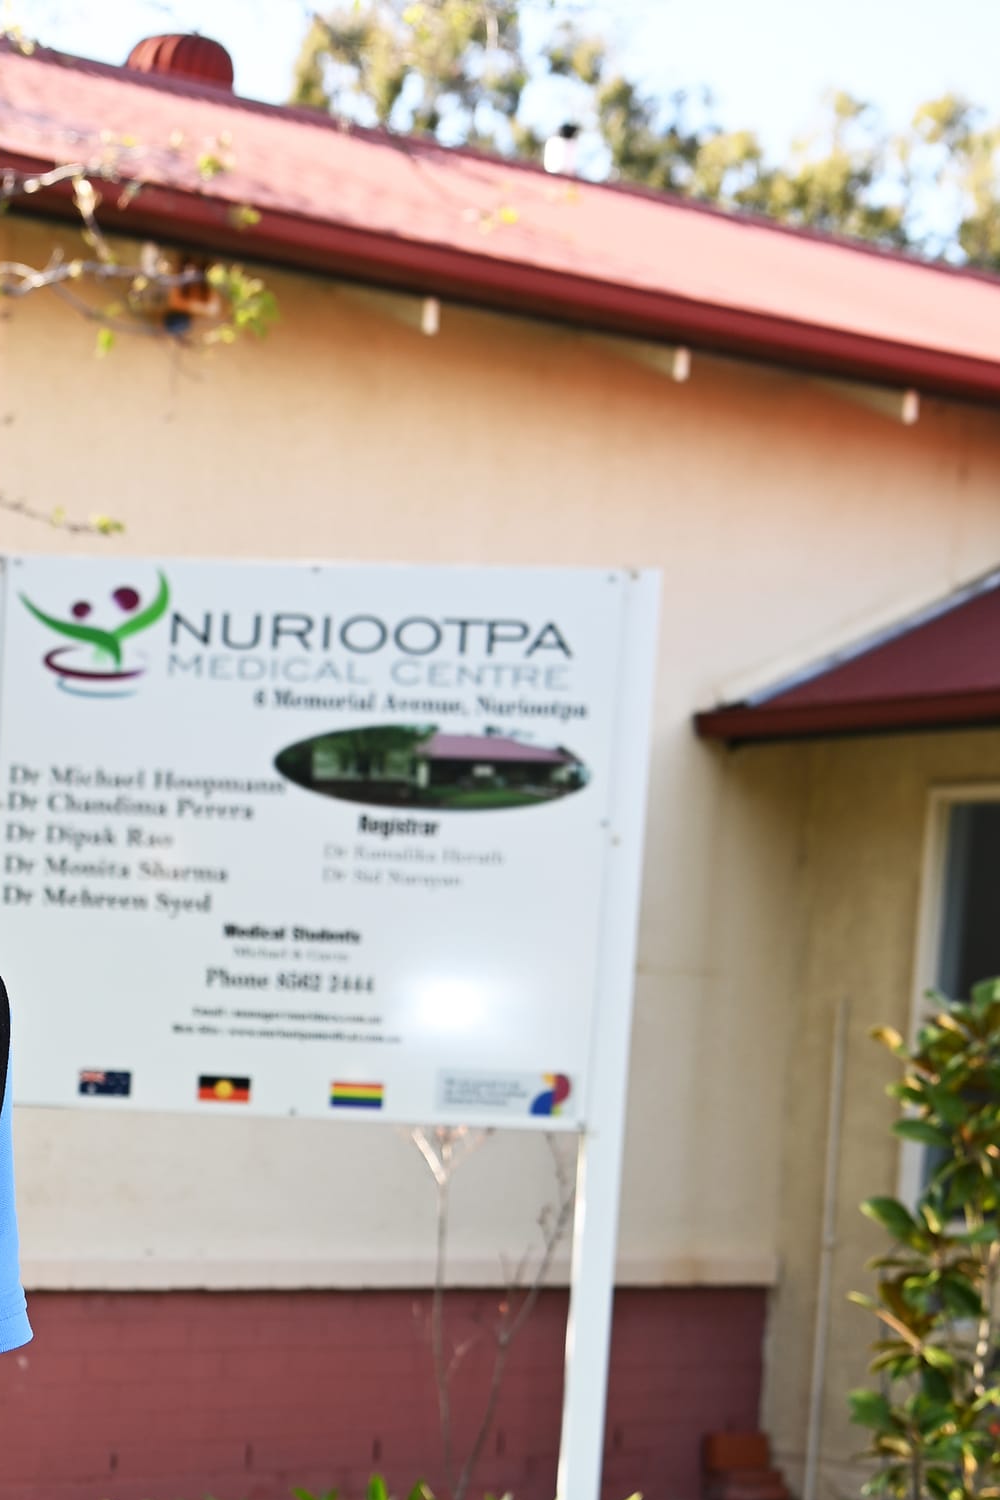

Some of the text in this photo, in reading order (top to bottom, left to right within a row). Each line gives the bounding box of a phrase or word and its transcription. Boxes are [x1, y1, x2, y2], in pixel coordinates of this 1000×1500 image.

[170, 611, 574, 659] NURIOOTPA
[167, 653, 571, 691] MEDICAL CENTRE
[272, 690, 376, 712] Memorial
[476, 698, 589, 722] Nuriootpa
[9, 765, 40, 785] Dr
[50, 766, 145, 790] Michael
[7, 791, 38, 812] Dr
[5, 823, 36, 843] Dr
[45, 824, 117, 851] Dipak
[358, 815, 440, 839] Registrar
[3, 855, 35, 875] Dr
[2, 885, 34, 906] Dr
[155, 893, 213, 919] Syed
[223, 924, 361, 944] Medical Students
[206, 967, 269, 989] Phone
